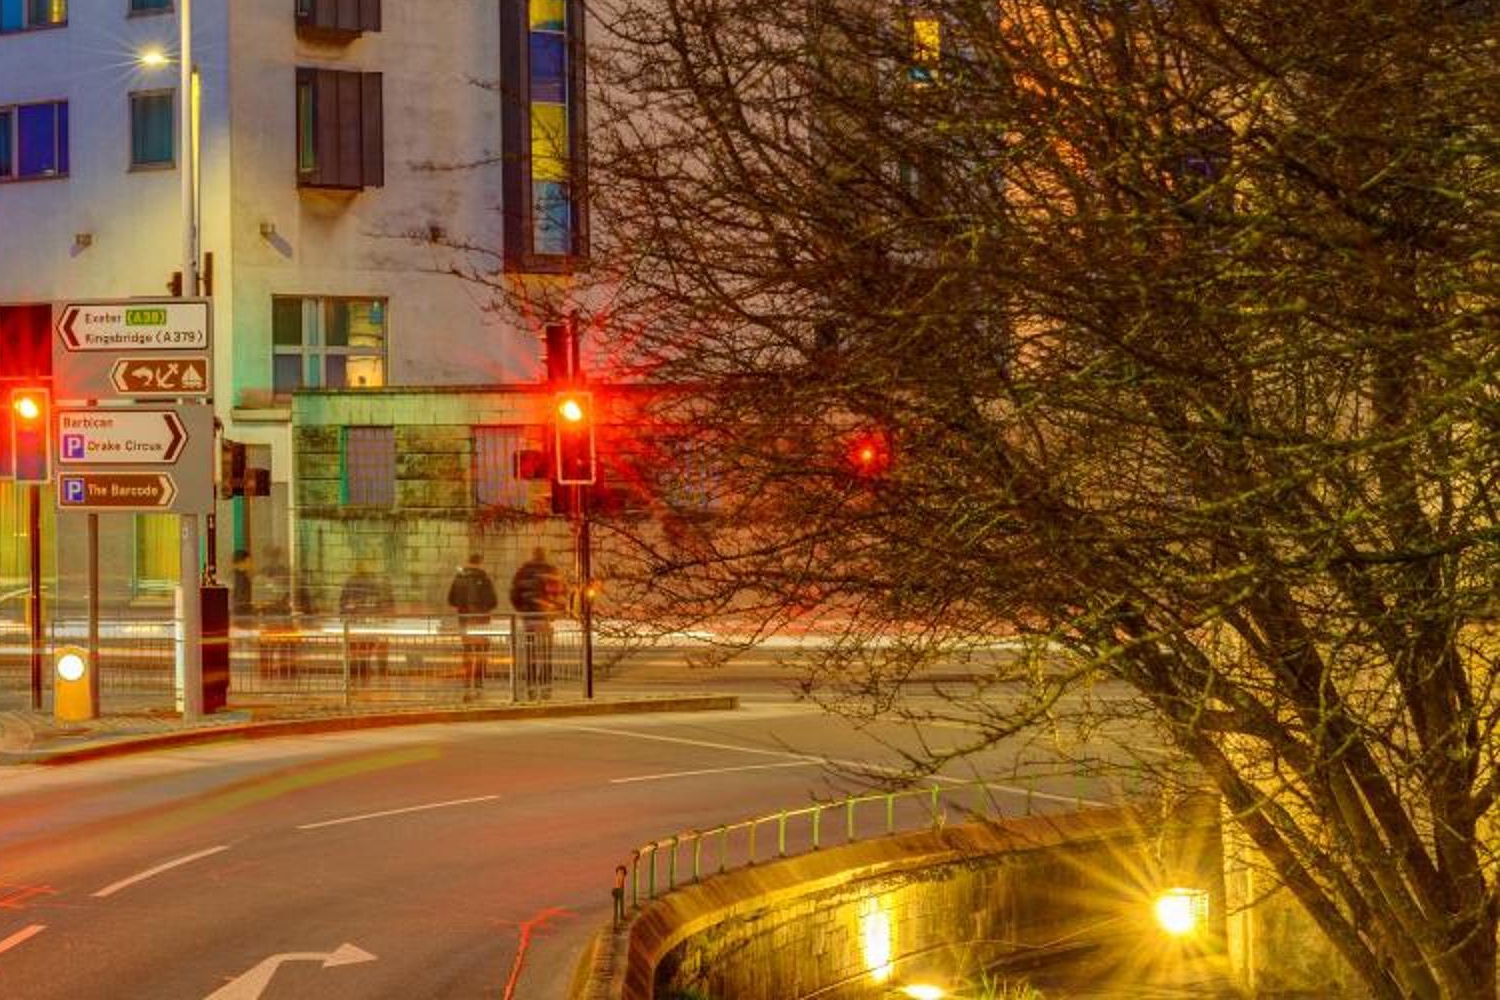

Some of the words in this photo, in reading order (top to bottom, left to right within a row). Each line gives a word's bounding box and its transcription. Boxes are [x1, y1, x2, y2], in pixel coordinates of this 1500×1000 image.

[85, 313, 121, 325] Exeter
[127, 310, 166, 325] (A38)
[85, 333, 152, 345] Kingsbridge
[63, 416, 114, 429] Barbican
[67, 436, 81, 457] P
[87, 440, 121, 451] Drake
[124, 440, 162, 452] Circus
[67, 481, 81, 501] P
[87, 483, 107, 496] The
[111, 483, 159, 497] Barcode
